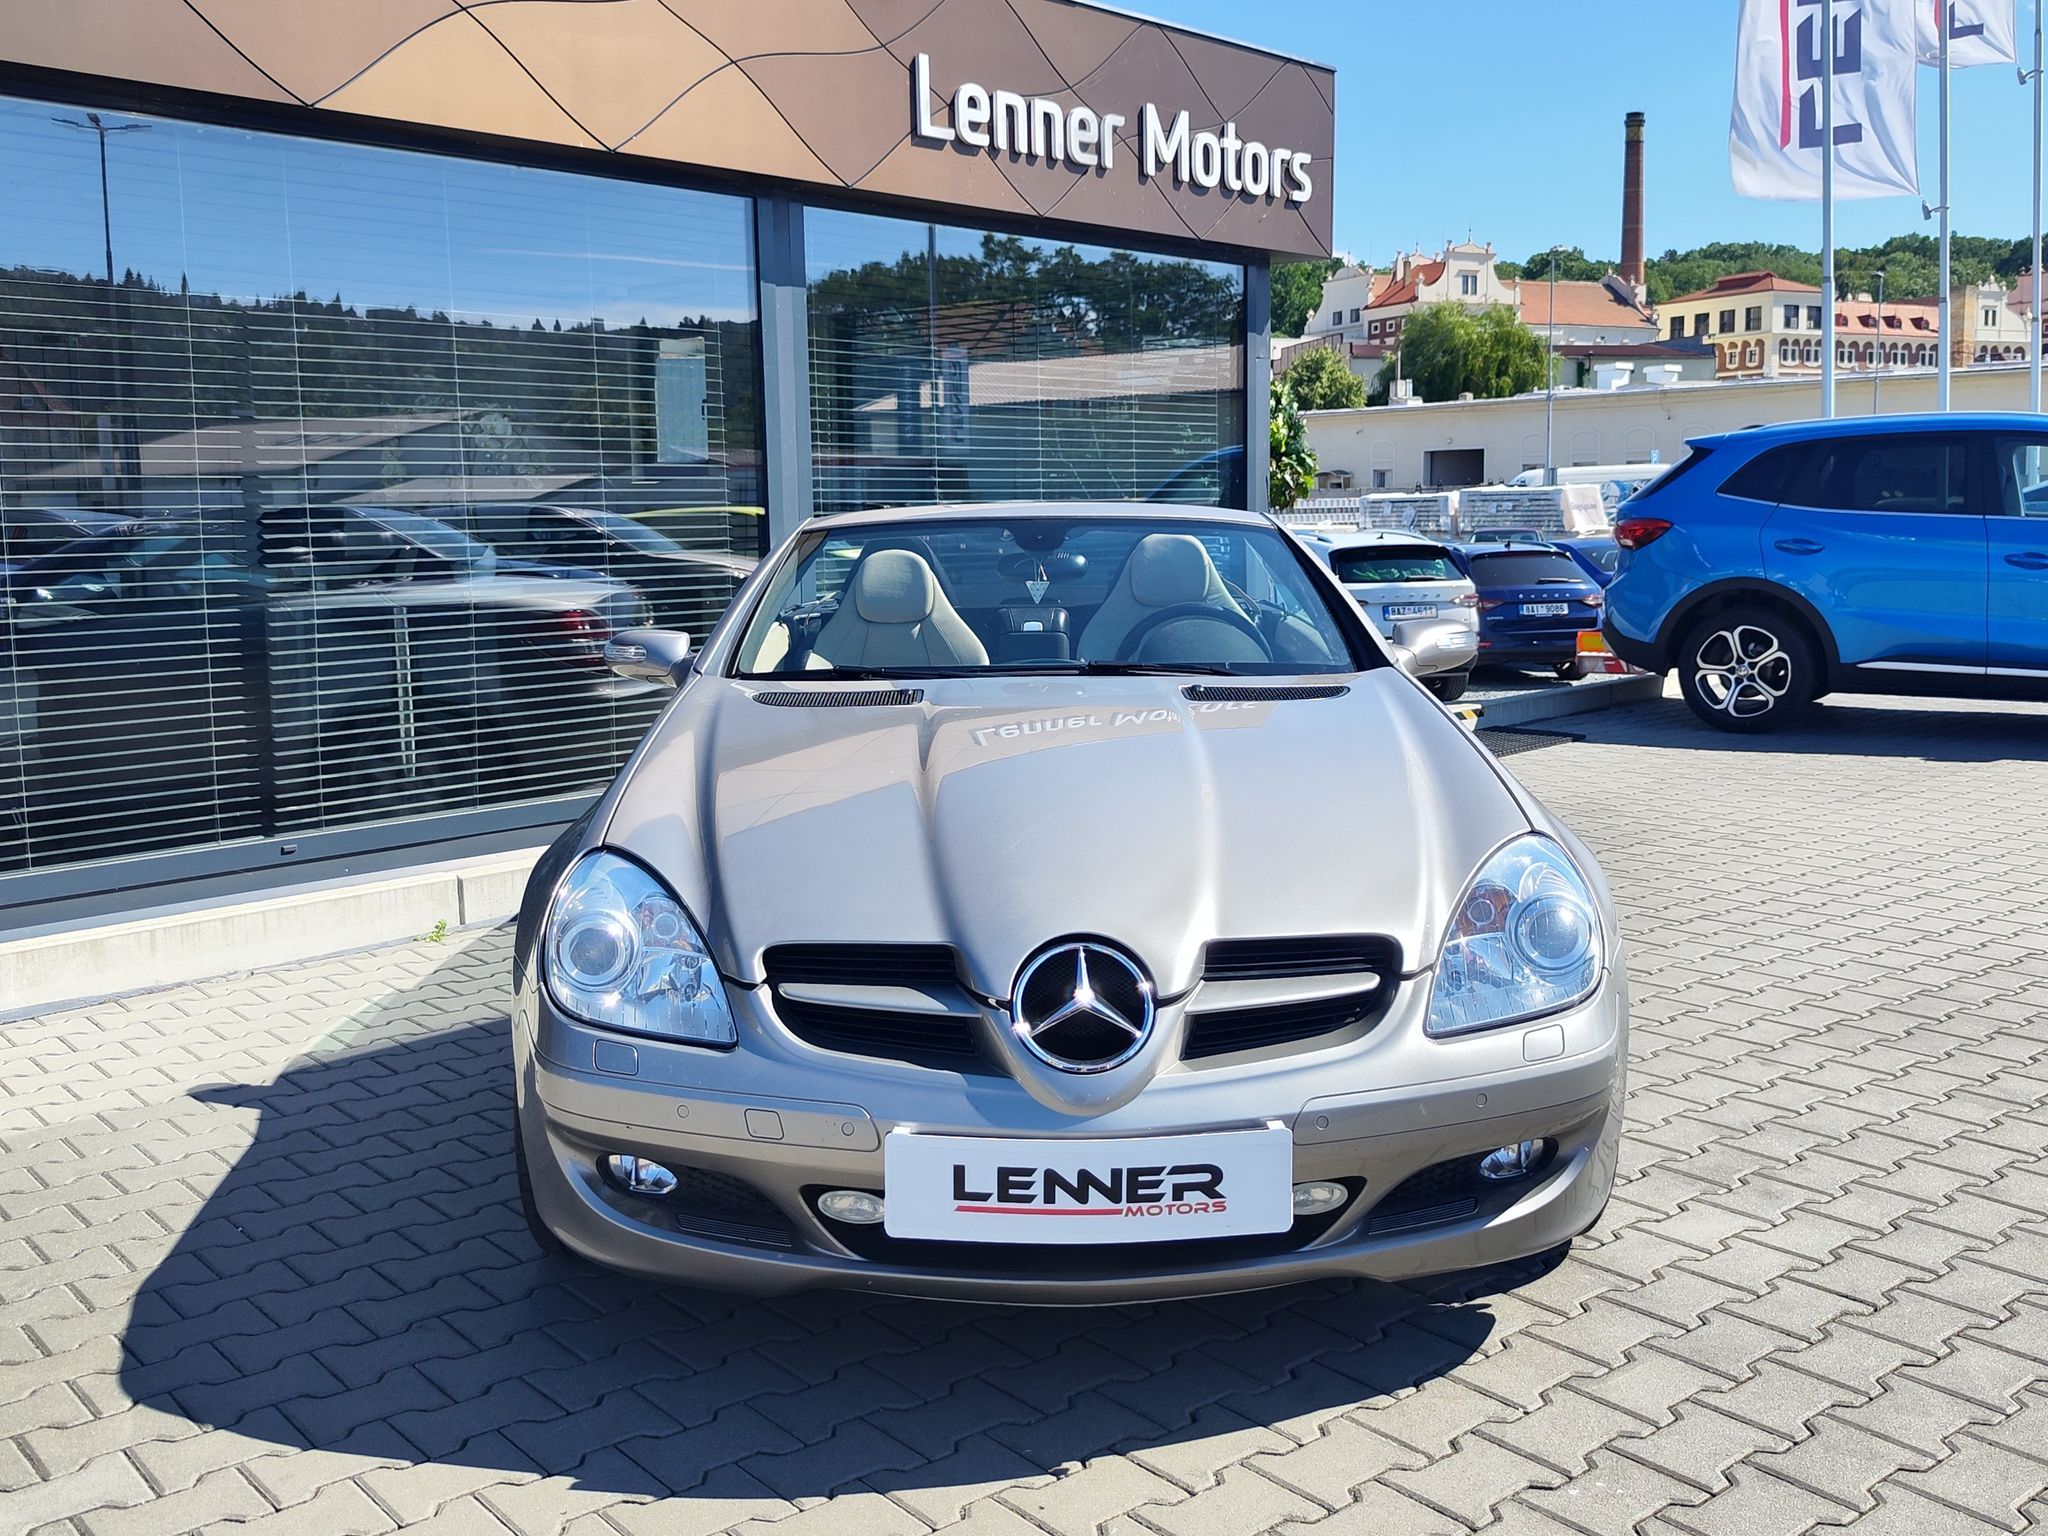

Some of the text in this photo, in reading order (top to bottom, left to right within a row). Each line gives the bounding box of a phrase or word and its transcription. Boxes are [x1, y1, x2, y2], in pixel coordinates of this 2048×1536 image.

[1797, 0, 1862, 149] LE
[915, 52, 1313, 202] Lenner Motors
[952, 1163, 1227, 1205] LENNER
[1123, 1200, 1228, 1218] MOTORS
